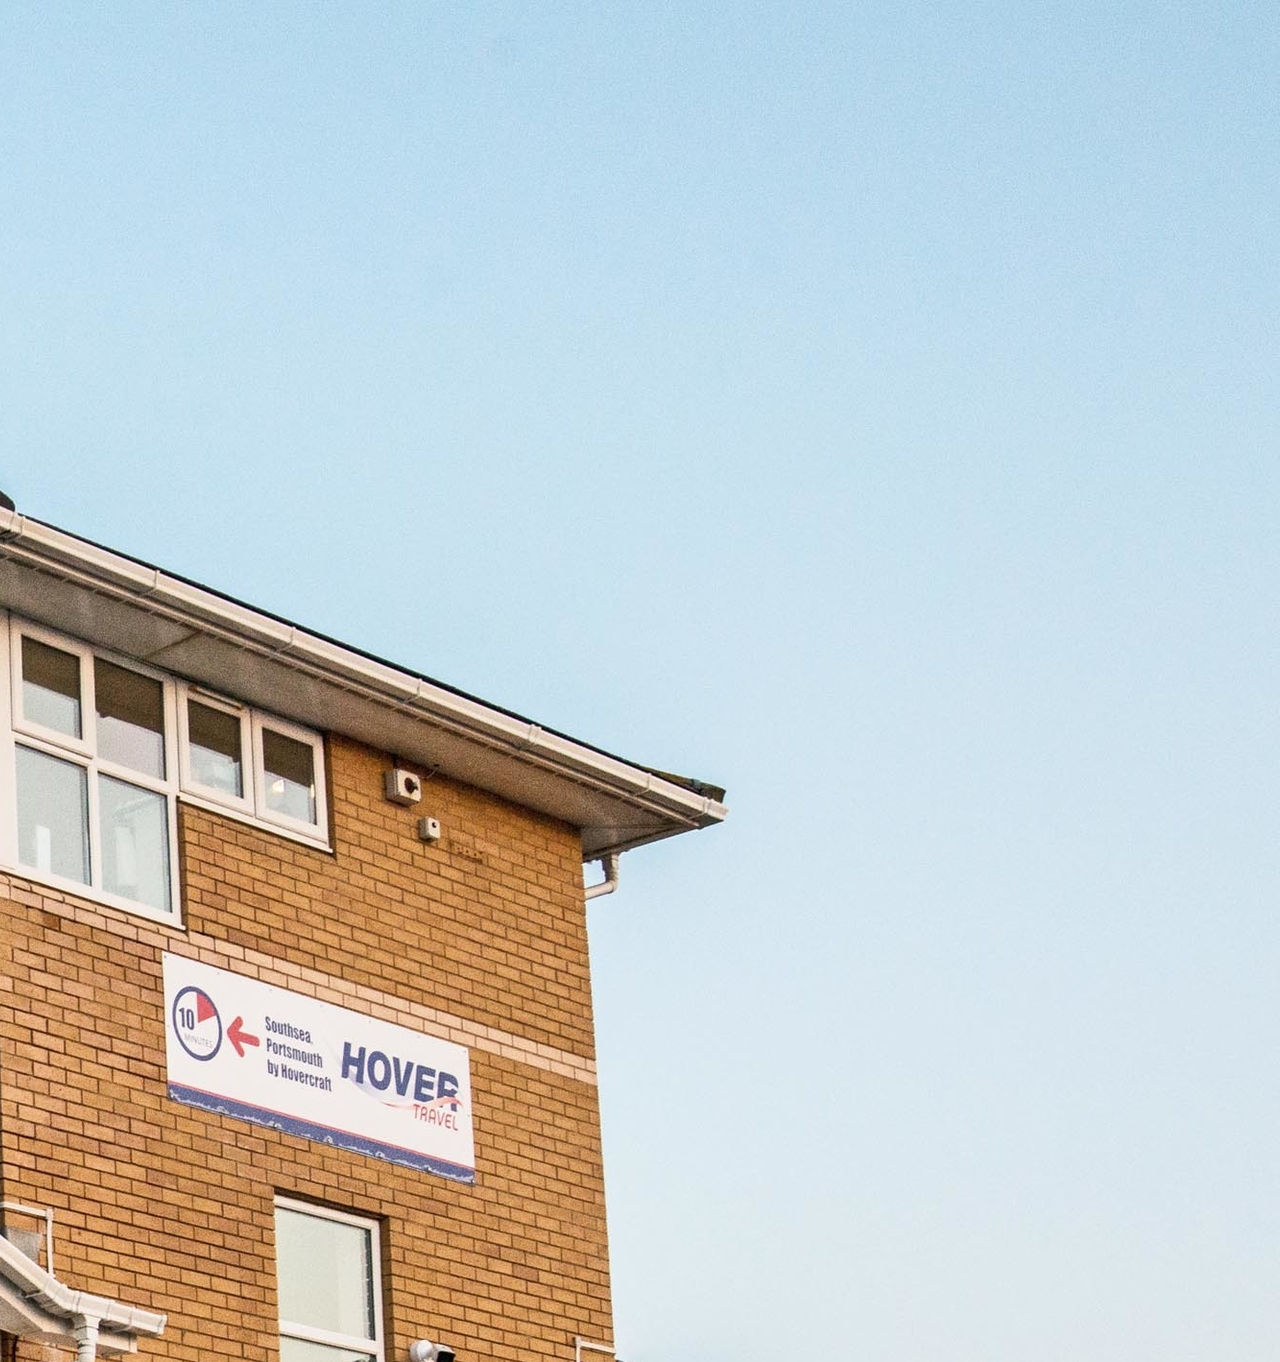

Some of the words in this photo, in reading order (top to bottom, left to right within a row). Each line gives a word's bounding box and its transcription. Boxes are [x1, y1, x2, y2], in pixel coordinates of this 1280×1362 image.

[179, 1007, 194, 1030] 10
[266, 1038, 323, 1068] Portsmouth
[267, 1059, 279, 1077] by
[281, 1063, 332, 1092] Hovercraft
[341, 1041, 459, 1112] HOVER
[413, 1103, 459, 1131] TRAVEL
